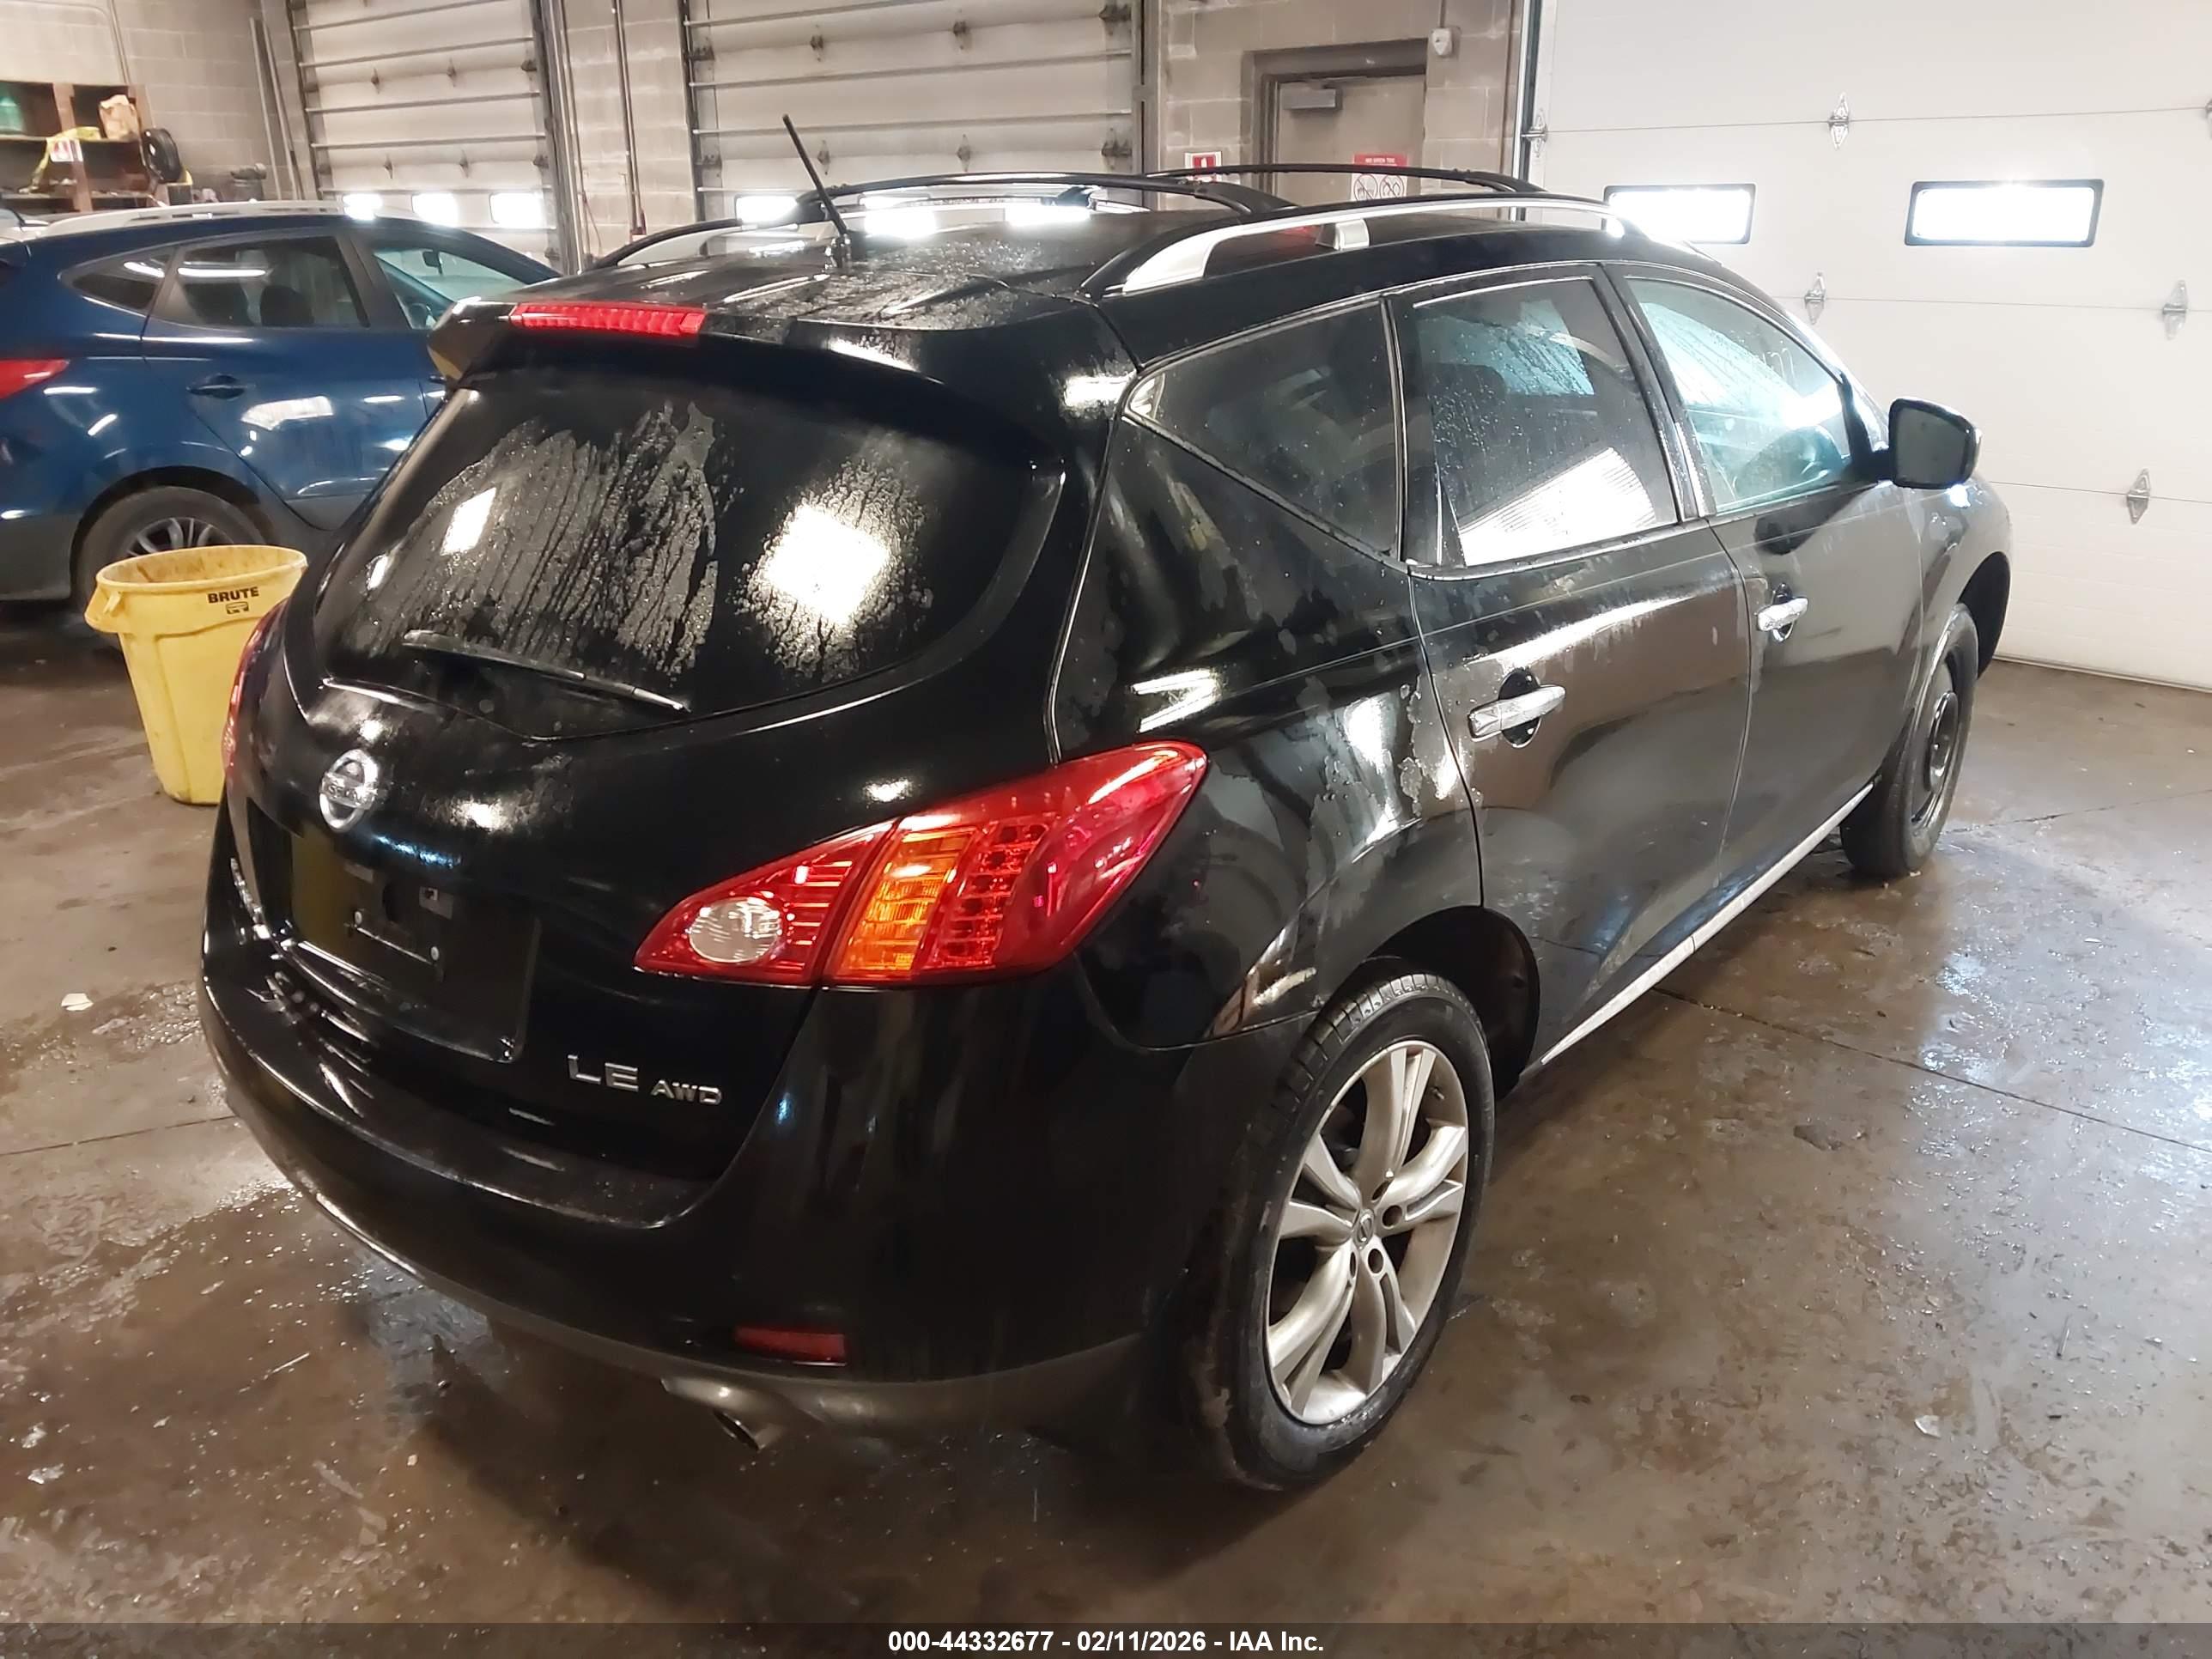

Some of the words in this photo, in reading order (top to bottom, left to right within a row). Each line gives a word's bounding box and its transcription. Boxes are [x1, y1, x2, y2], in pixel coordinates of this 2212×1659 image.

[207, 586, 259, 604] BRUTE
[567, 1054, 639, 1092] LE
[650, 1079, 723, 1105] AWD
